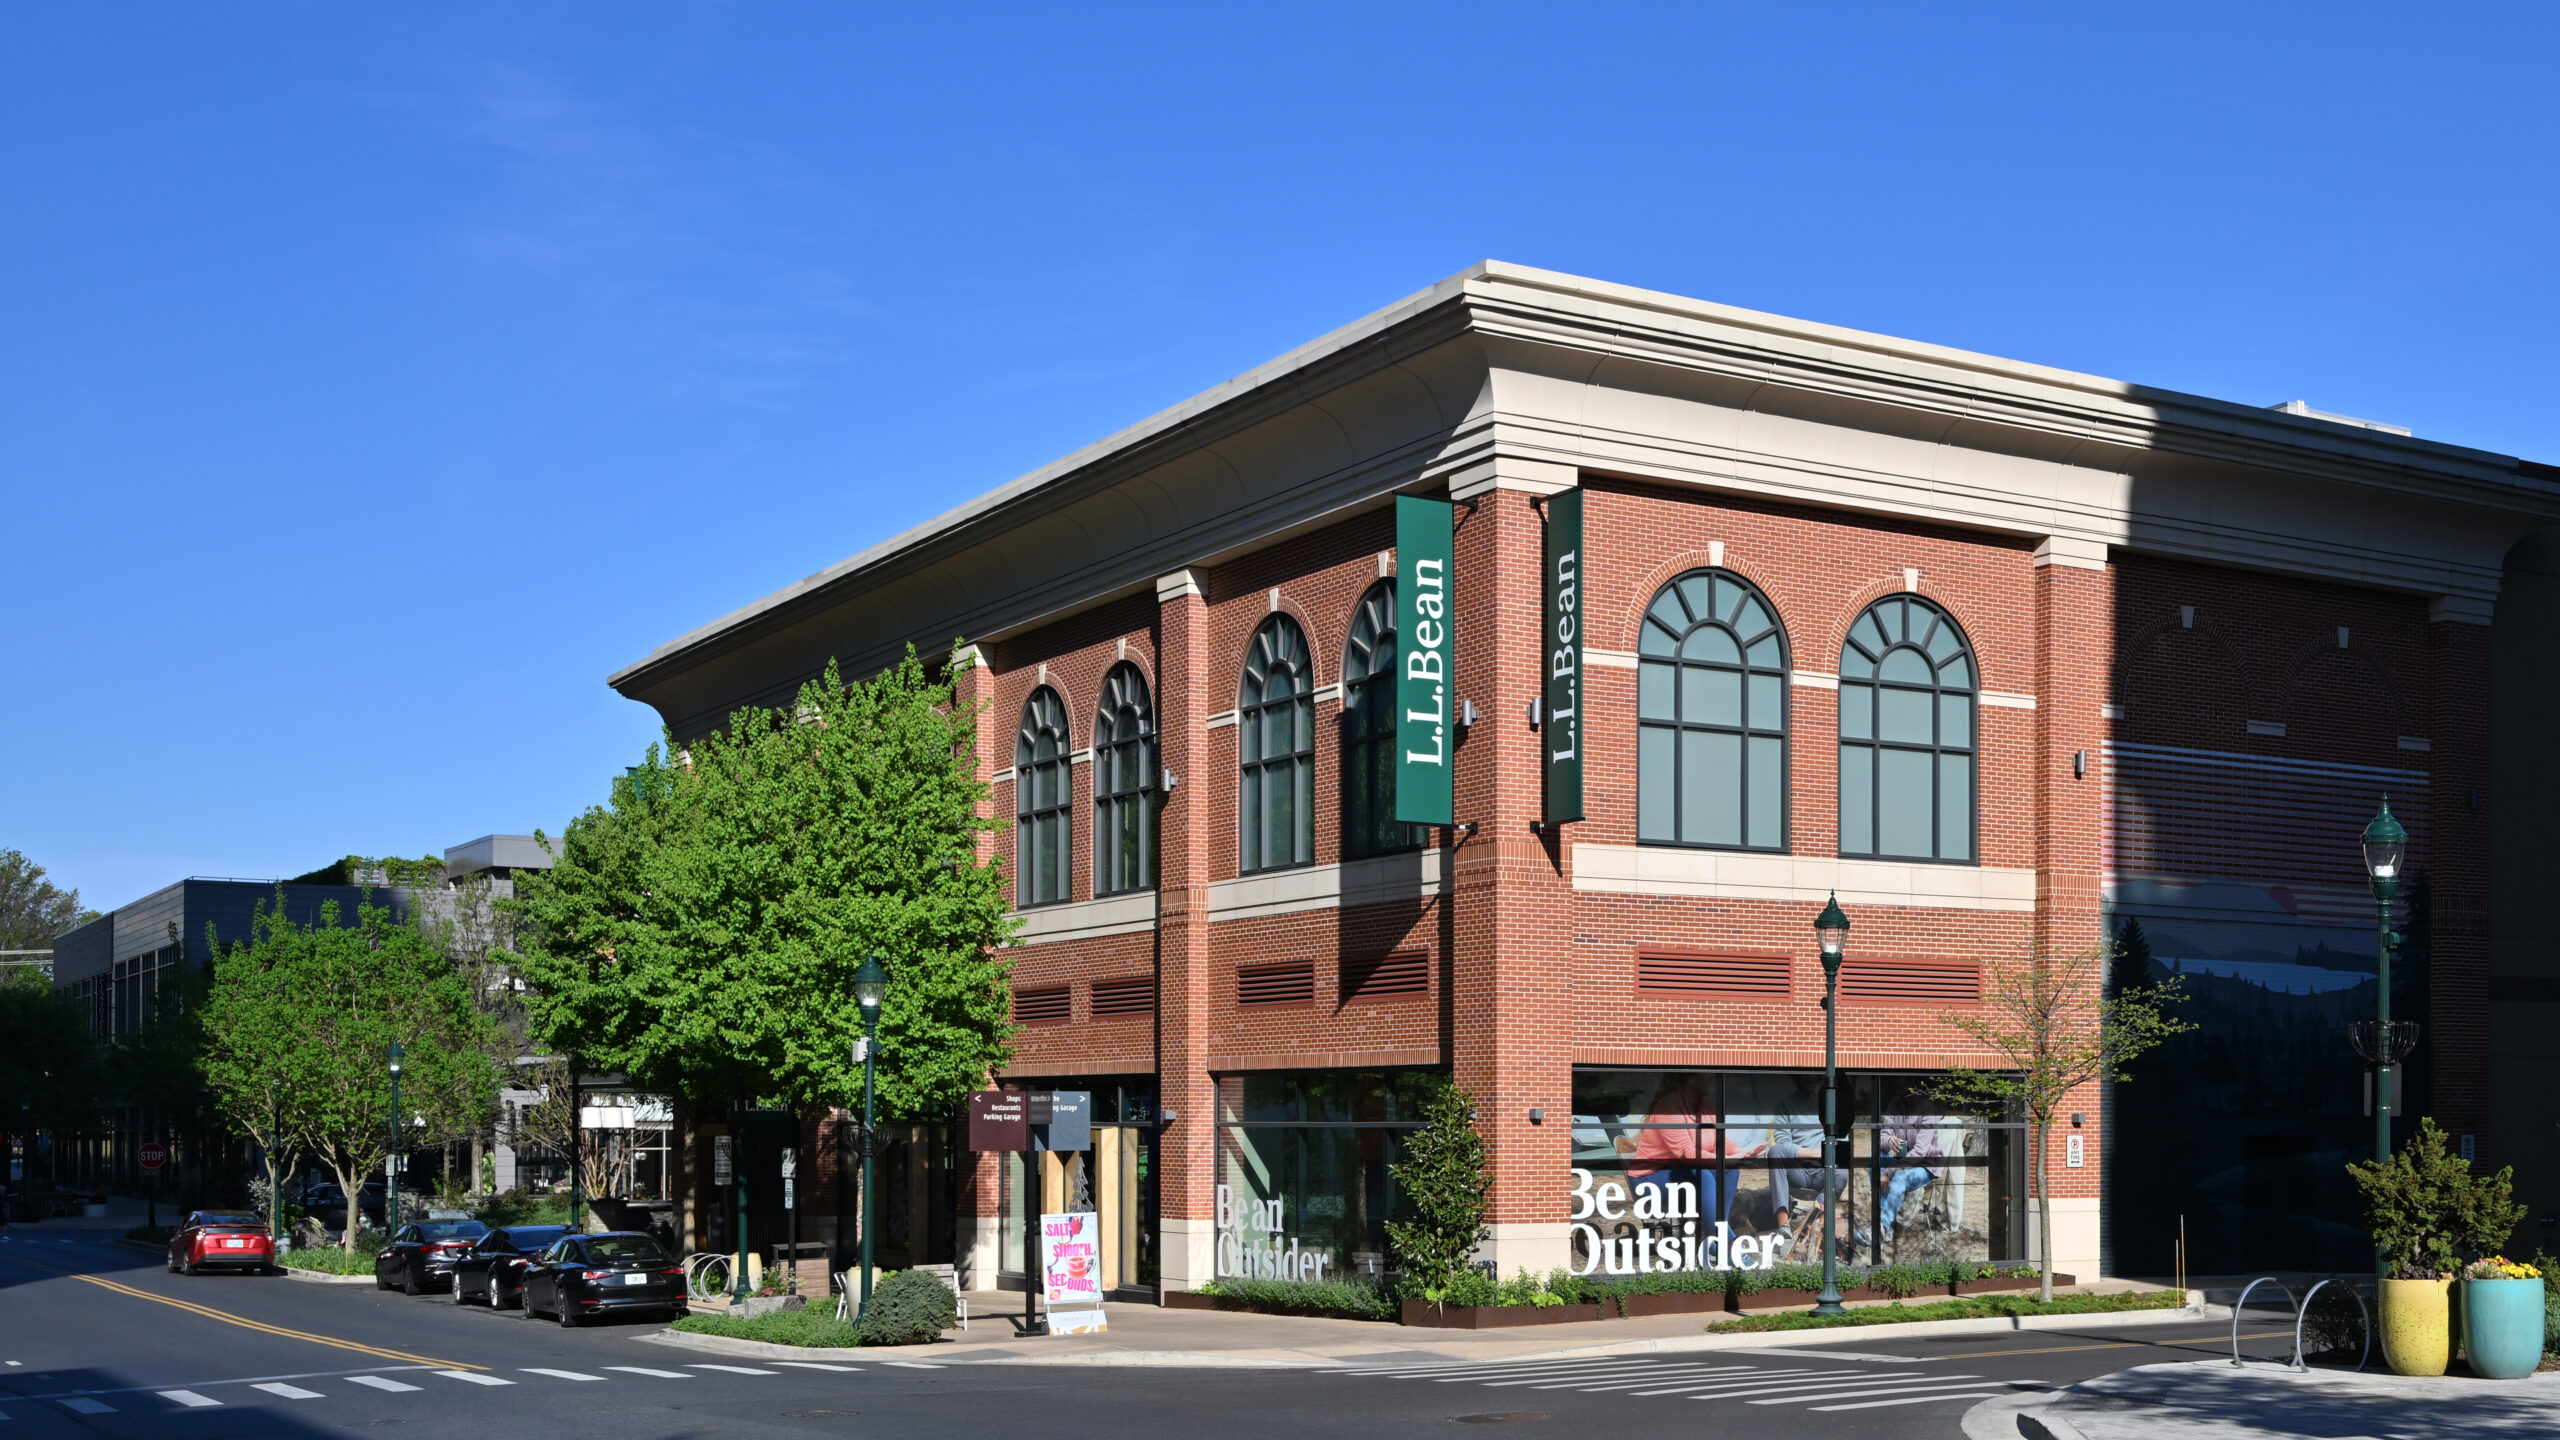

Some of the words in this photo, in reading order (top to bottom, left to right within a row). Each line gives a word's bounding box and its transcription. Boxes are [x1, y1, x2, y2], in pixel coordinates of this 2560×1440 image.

[1406, 558, 1444, 767] L.L.Bean
[1552, 549, 1575, 764] L.L.Bean
[983, 1113, 1002, 1121] Parking
[1003, 1113, 1021, 1121] Garage
[1006, 1095, 1021, 1103] Shops
[140, 1151, 165, 1161] STOP
[1251, 1198, 1284, 1232] an
[1633, 1181, 1700, 1220] an
[1217, 1231, 1329, 1282] Outsider
[1571, 1221, 1785, 1276] Outsider
